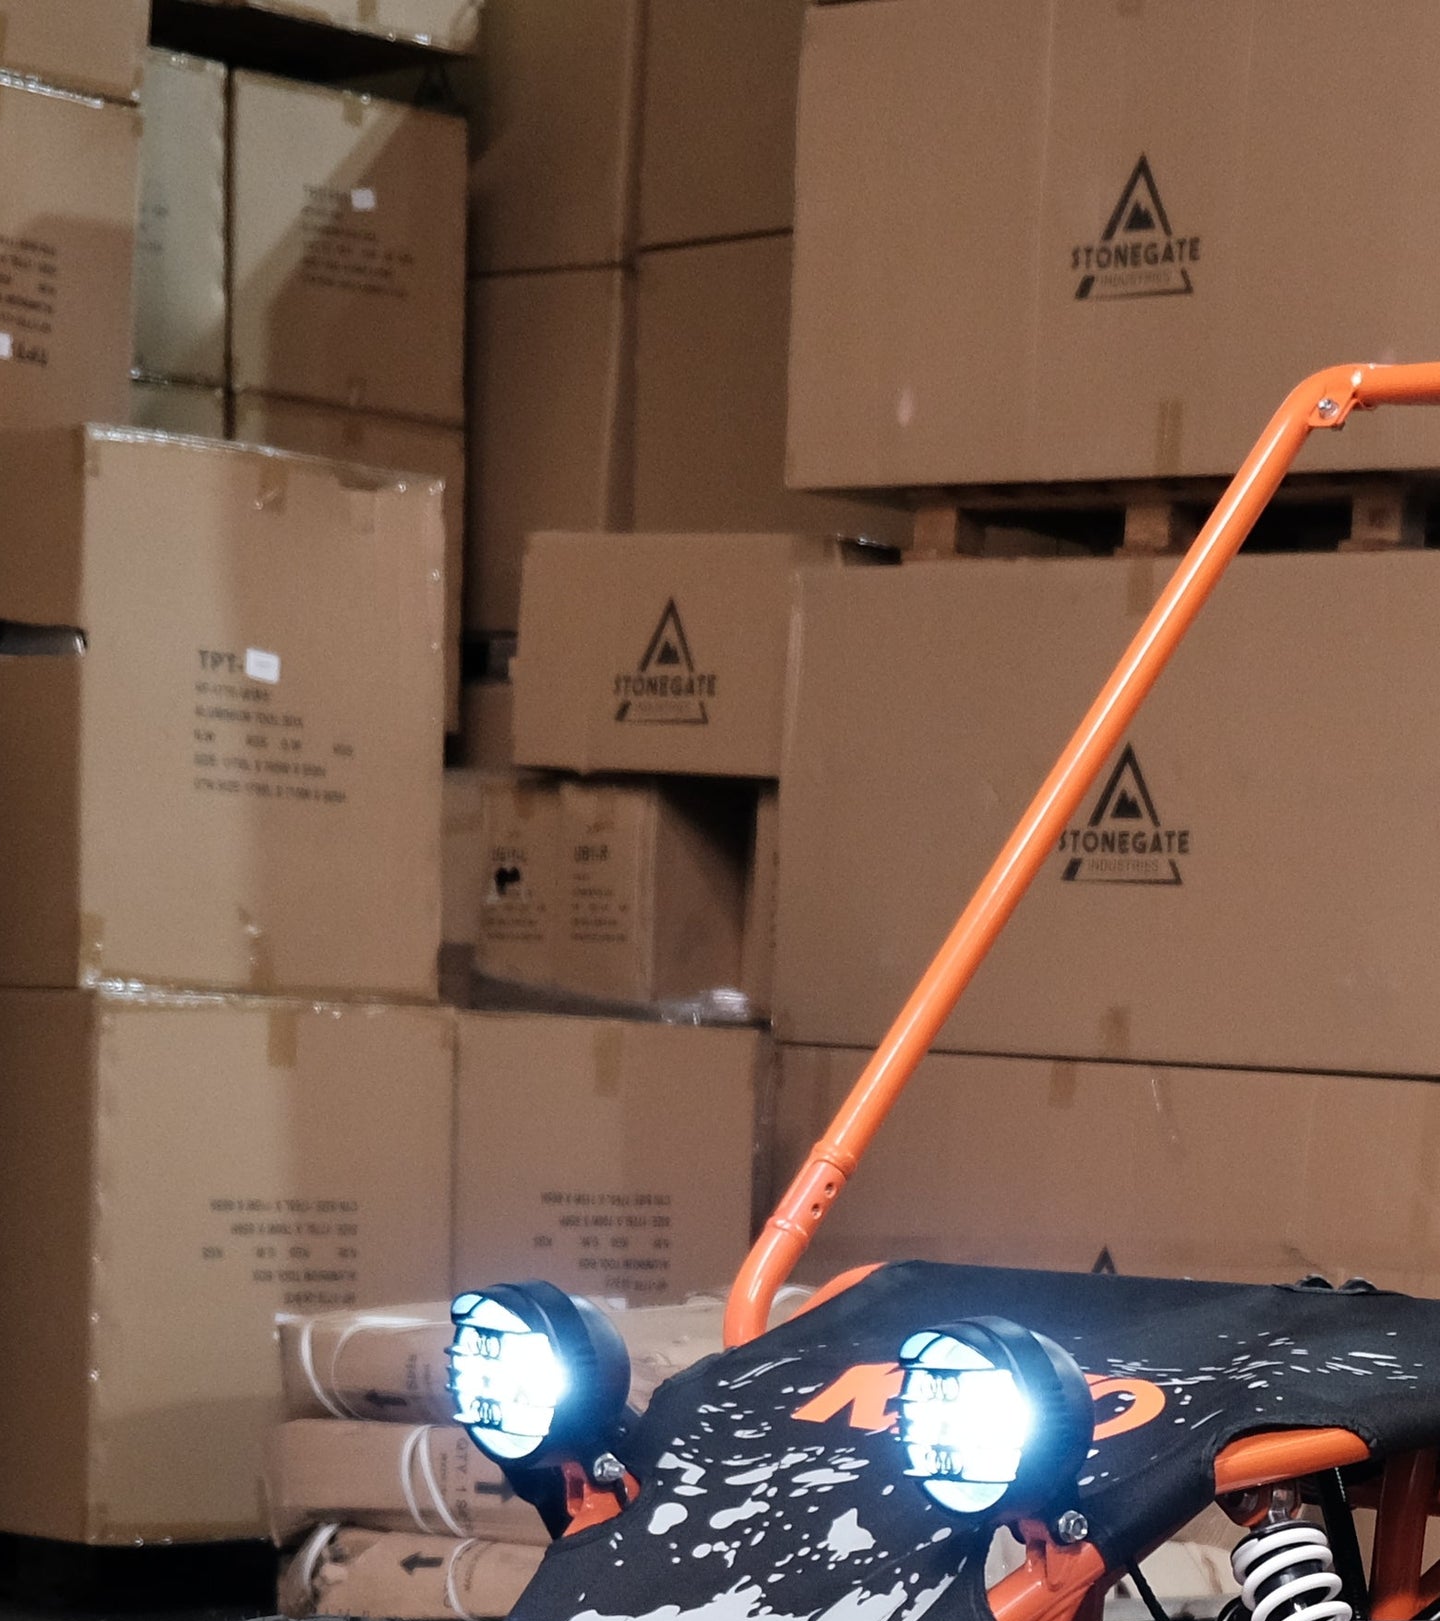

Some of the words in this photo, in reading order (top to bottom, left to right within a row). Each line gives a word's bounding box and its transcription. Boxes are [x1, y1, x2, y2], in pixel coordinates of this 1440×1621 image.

[1071, 236, 1201, 270] STONEGATE
[614, 672, 717, 698] STONEGATE
[1058, 829, 1190, 854] STONEGATE
